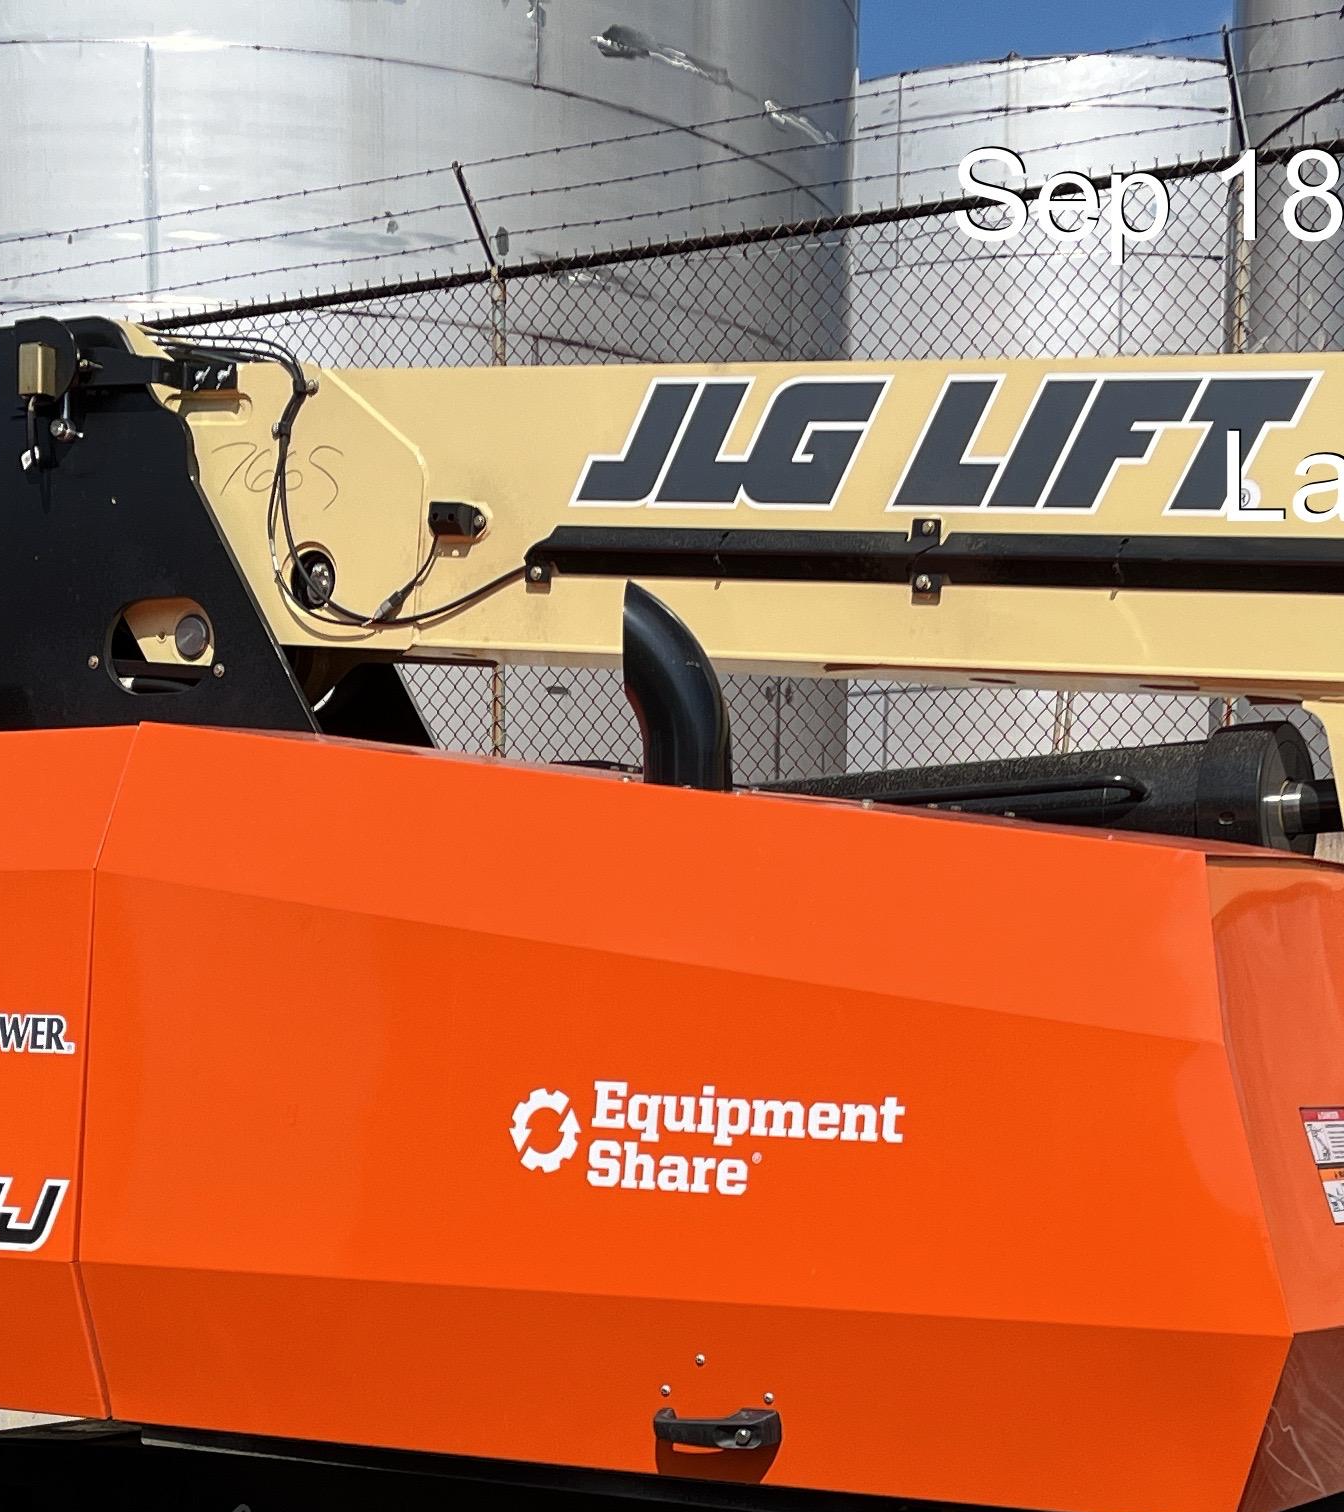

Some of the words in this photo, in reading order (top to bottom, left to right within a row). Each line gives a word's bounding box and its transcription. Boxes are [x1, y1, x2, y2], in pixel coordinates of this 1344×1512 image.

[572, 378, 892, 509] JLG
[885, 373, 1323, 514] LIFT
[591, 1080, 906, 1146] Equipment
[586, 1139, 749, 1196] Share
